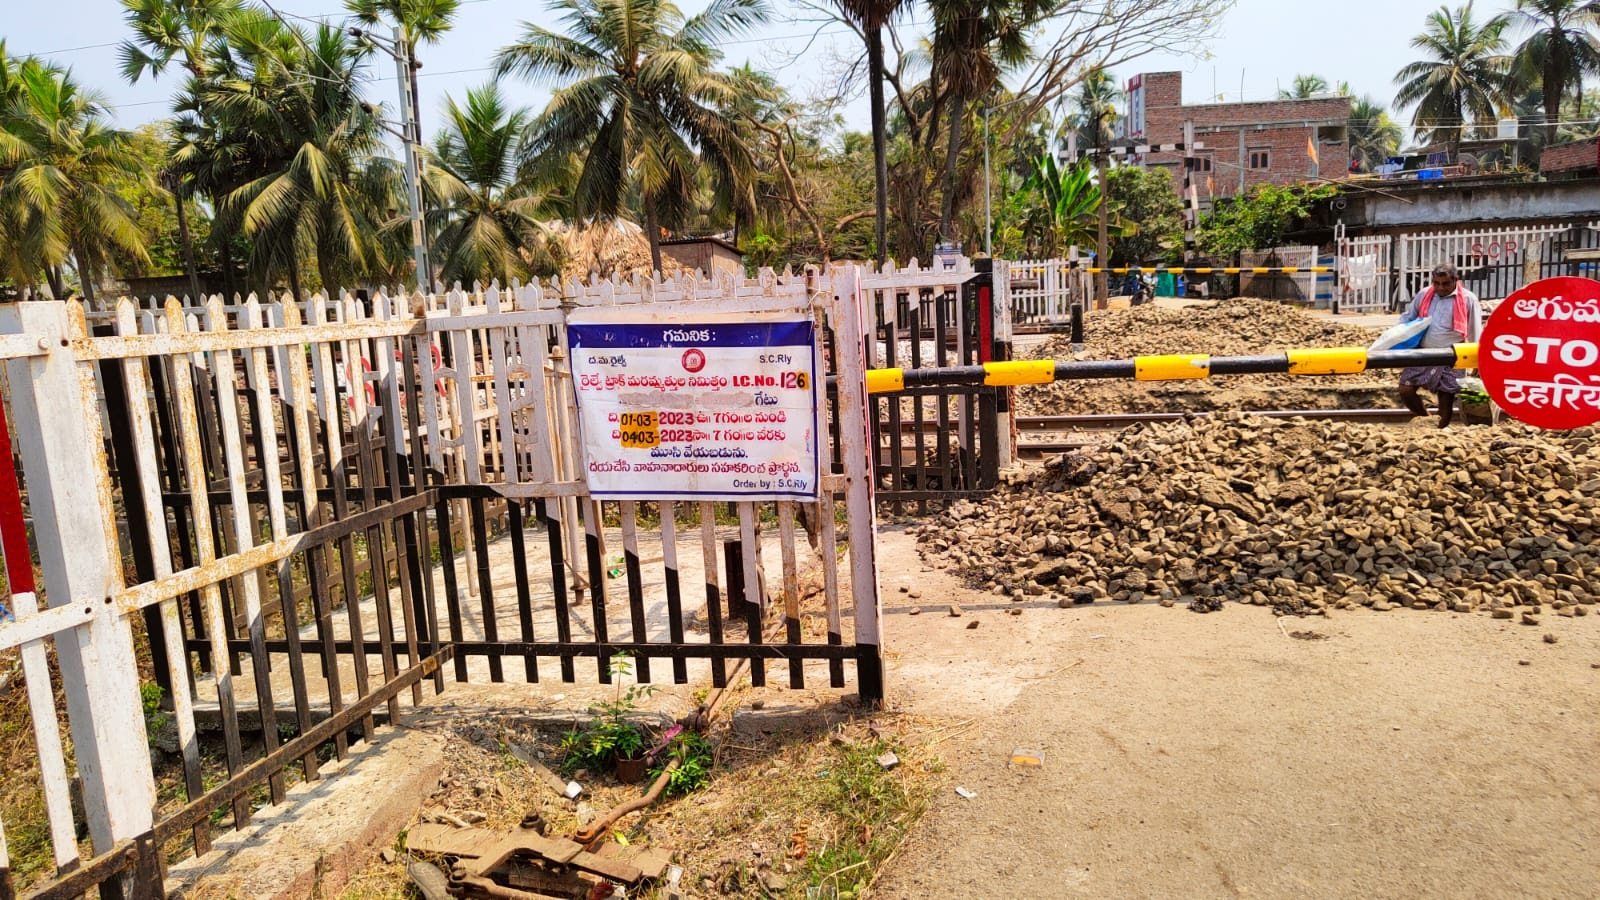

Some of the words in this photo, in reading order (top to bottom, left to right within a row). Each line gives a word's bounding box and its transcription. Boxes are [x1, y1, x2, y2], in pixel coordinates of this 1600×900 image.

[1490, 334, 1600, 368] STO
[759, 354, 792, 365] S.C.Rly
[733, 479, 757, 488] Order
